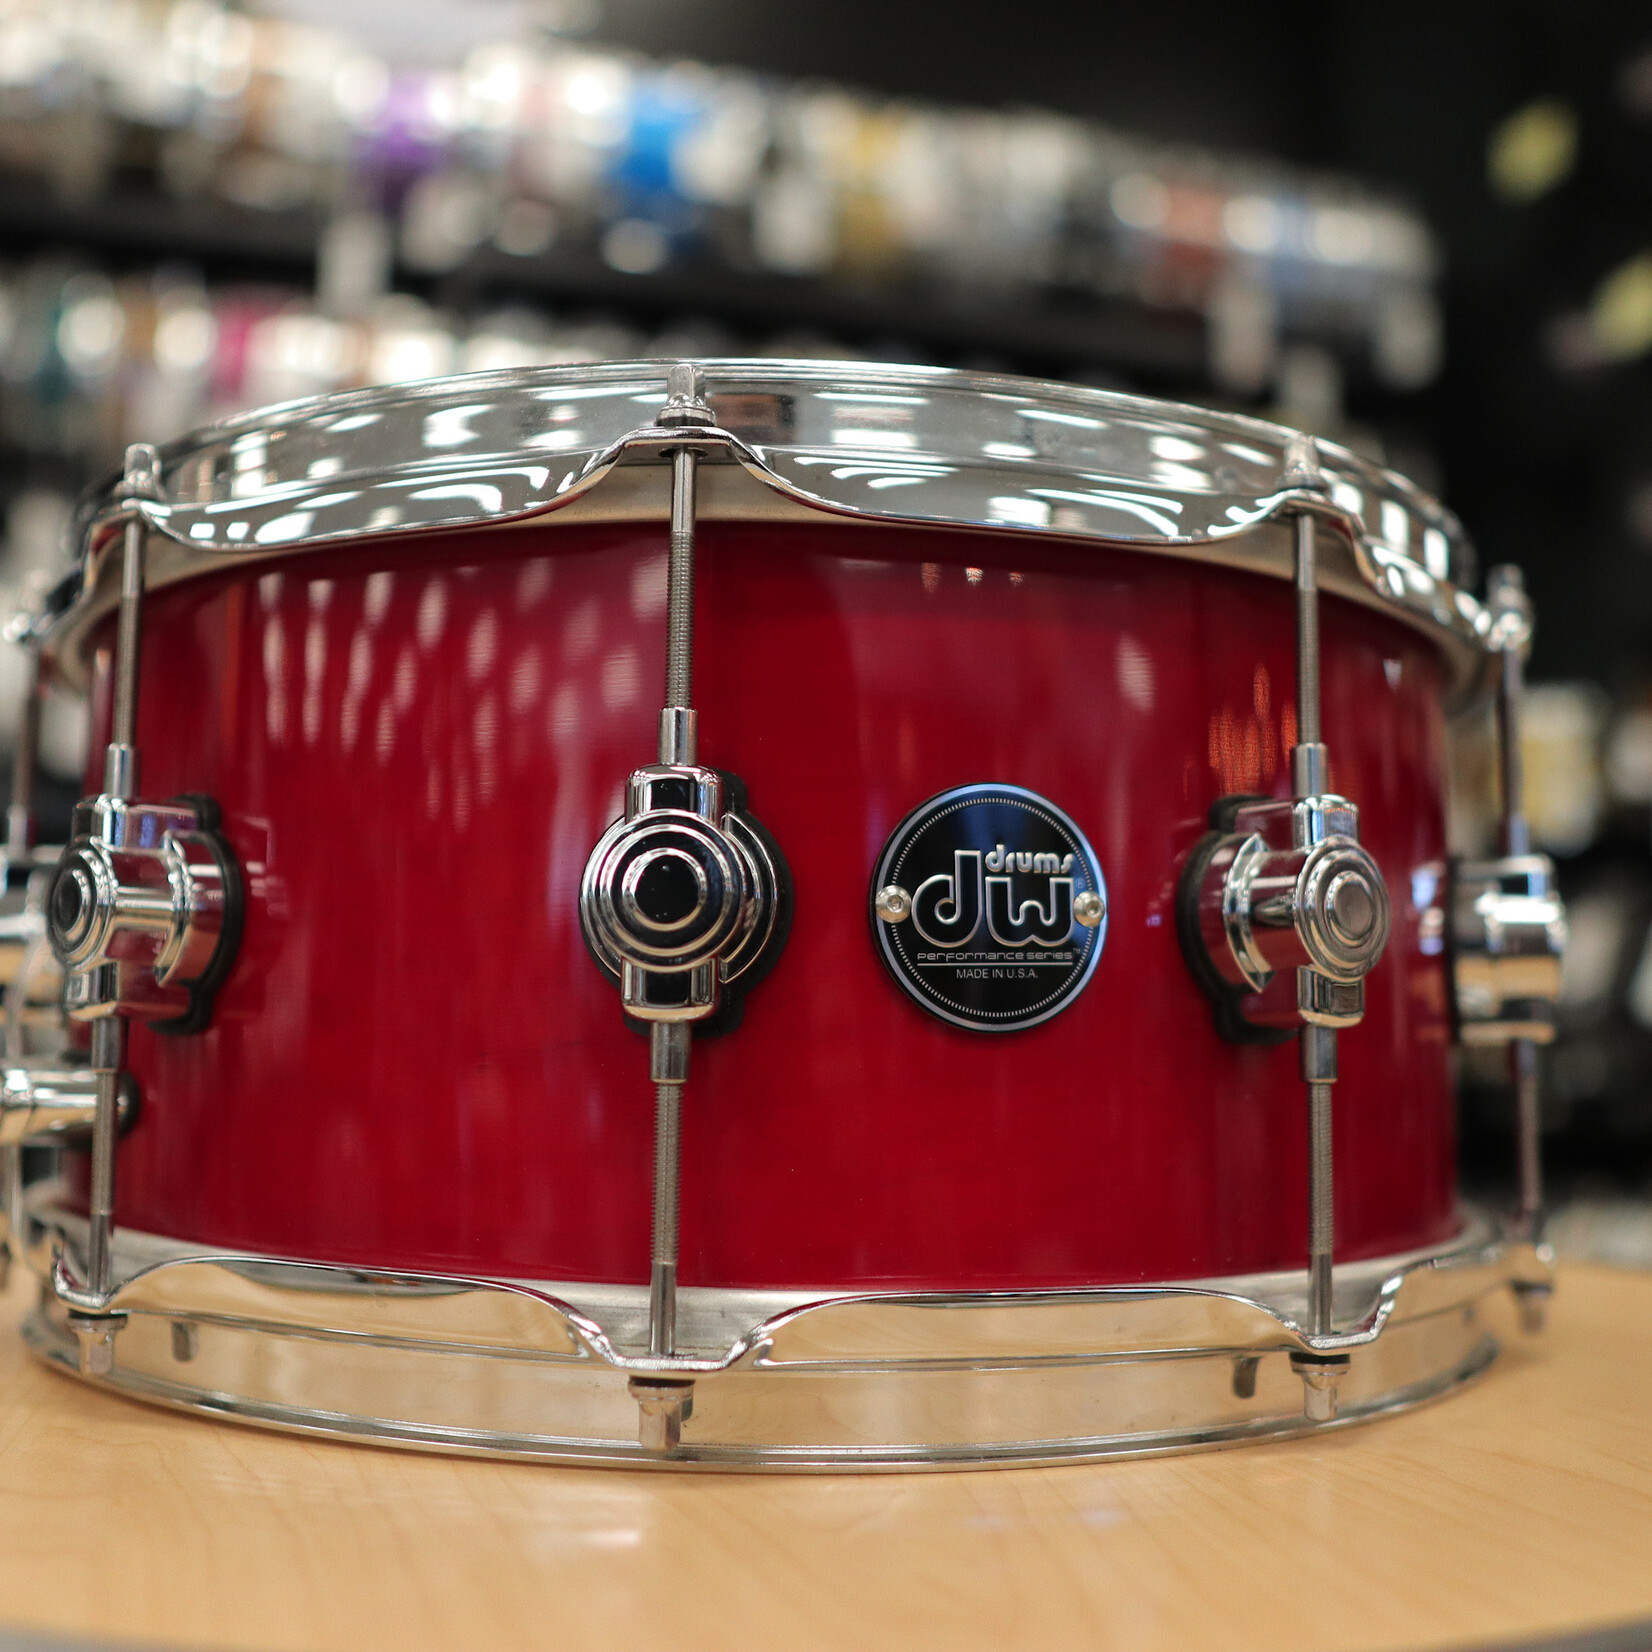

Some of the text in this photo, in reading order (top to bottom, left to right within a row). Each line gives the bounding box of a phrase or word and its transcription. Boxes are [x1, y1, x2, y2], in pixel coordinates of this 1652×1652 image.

[985, 844, 1075, 873] drums
[911, 850, 1075, 948] dw
[917, 951, 1024, 962] performance
[1026, 951, 1072, 960] series
[956, 968, 1039, 979] MADE IN U.S.A.
